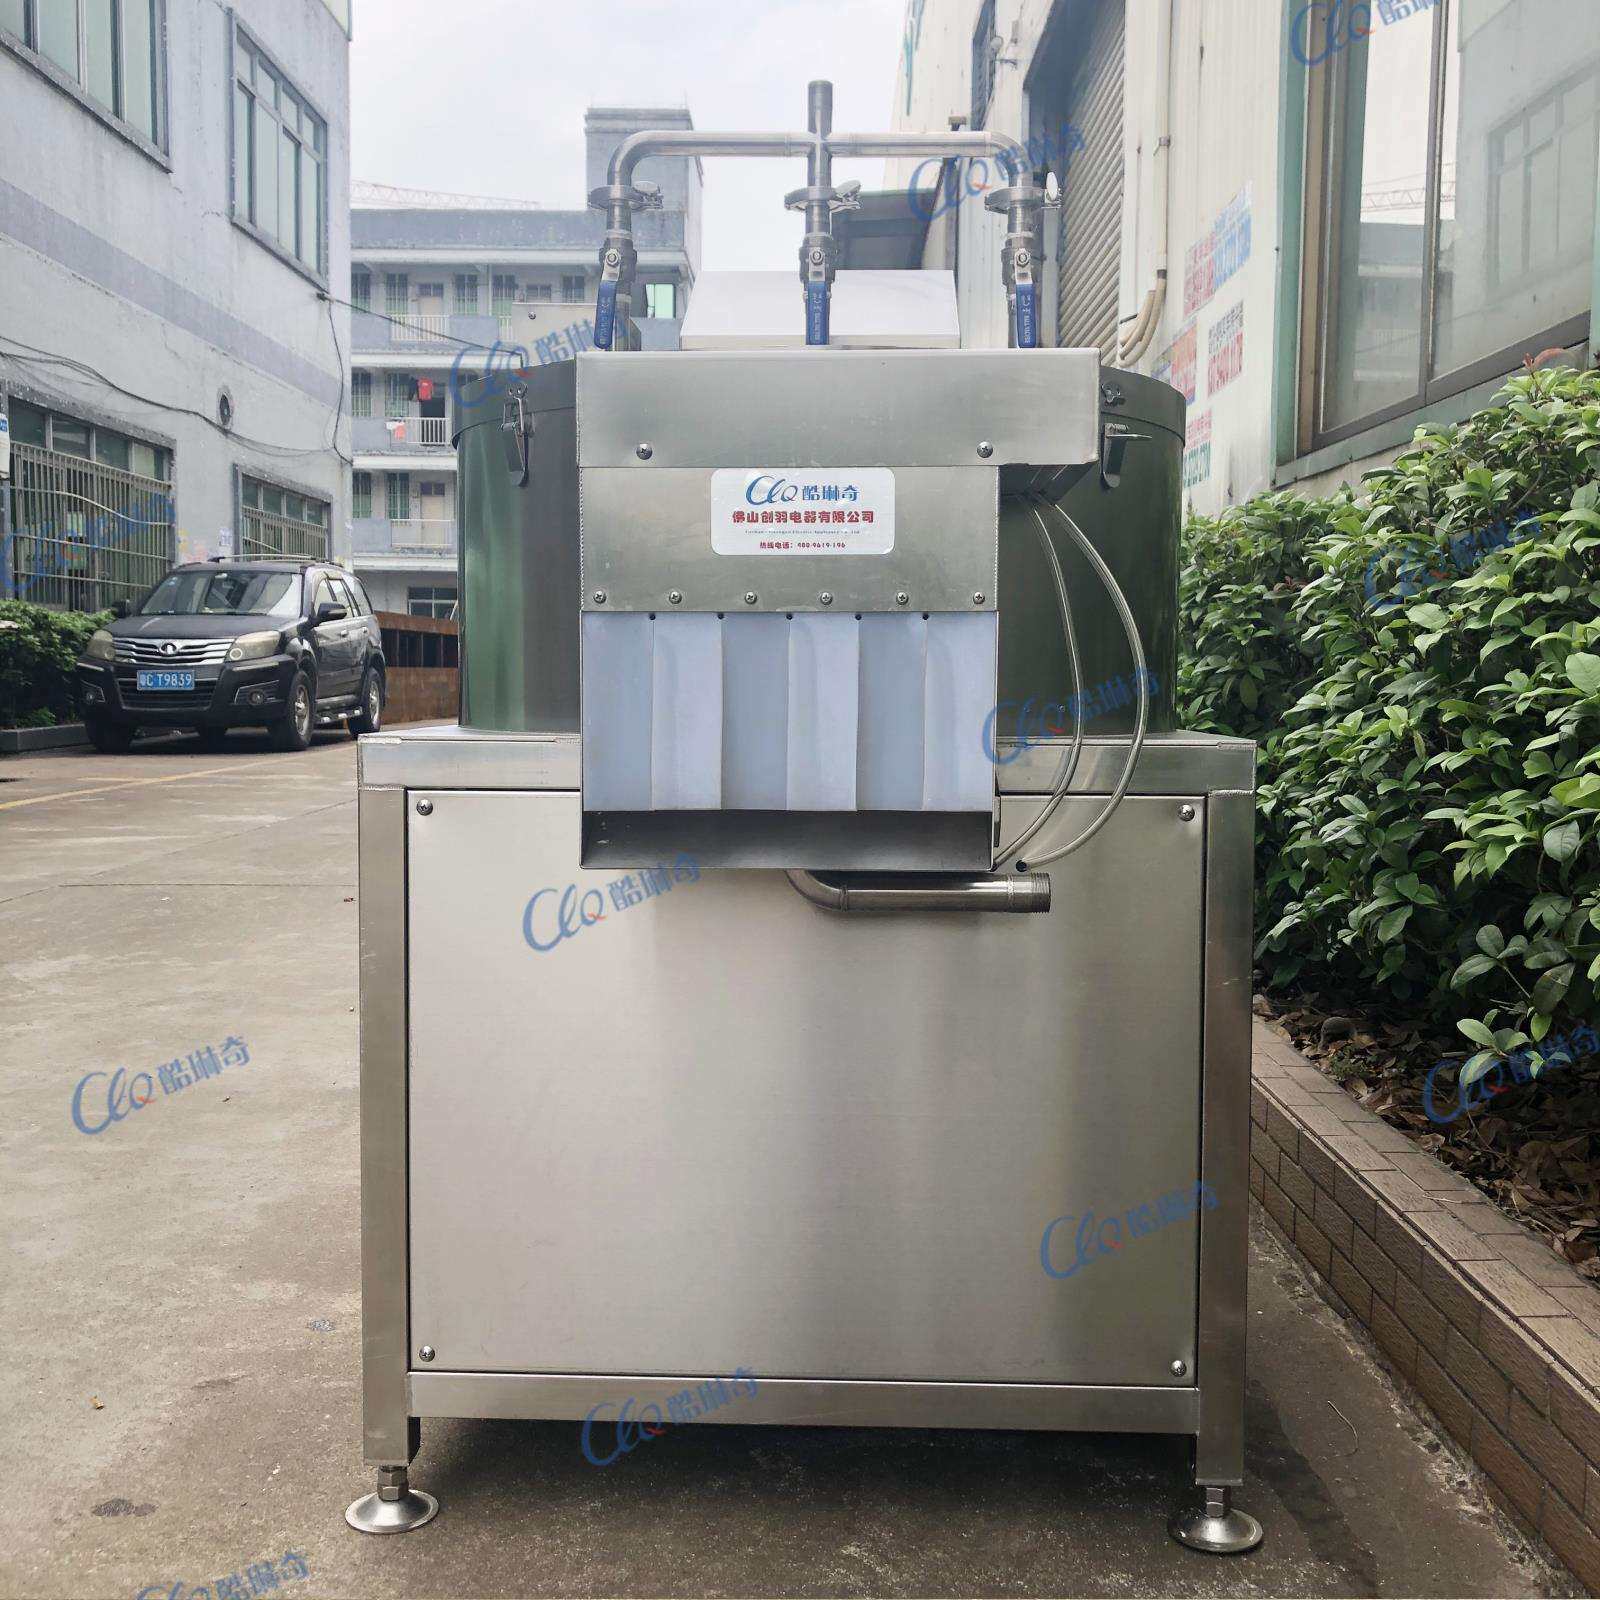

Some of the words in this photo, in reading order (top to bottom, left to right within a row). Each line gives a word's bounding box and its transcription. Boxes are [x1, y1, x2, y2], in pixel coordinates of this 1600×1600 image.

[801, 484, 860, 502] 酷琳奇
[732, 510, 875, 524] 佛山创羽电器有限公司
